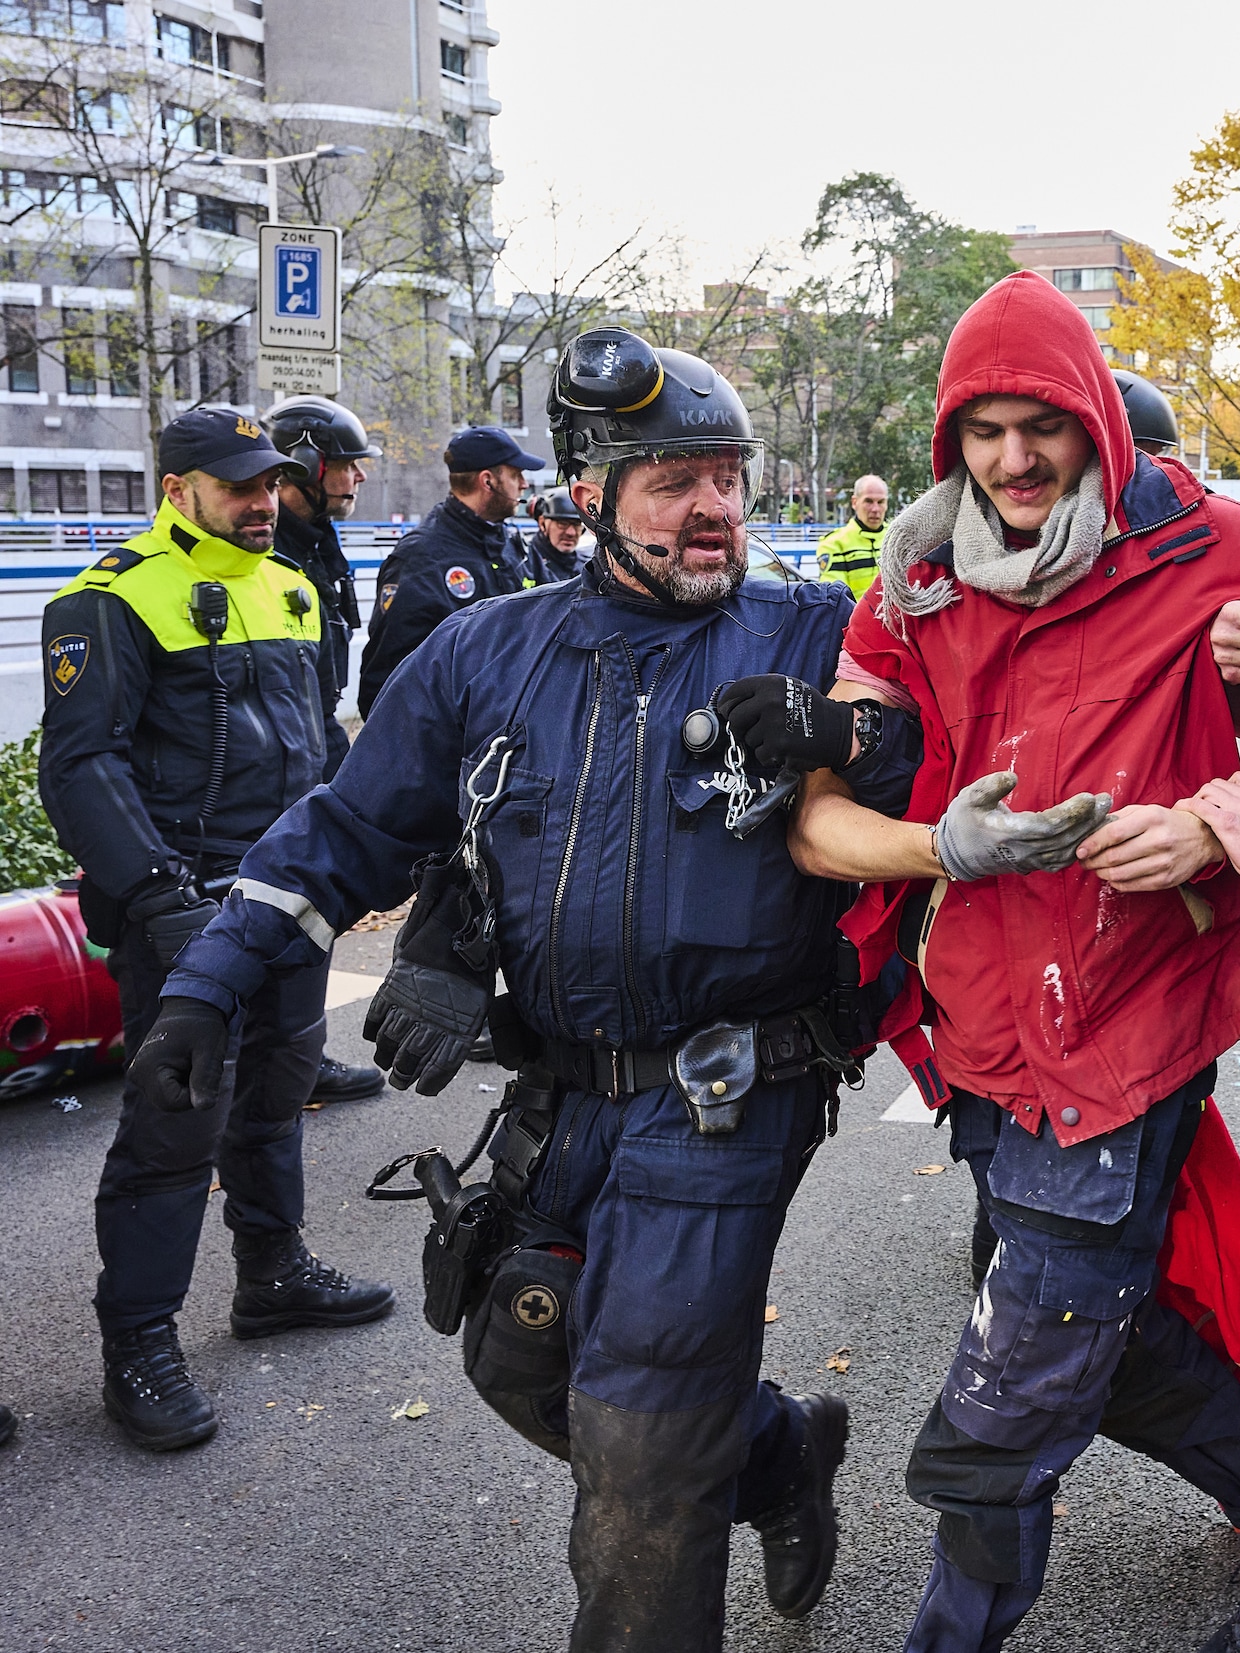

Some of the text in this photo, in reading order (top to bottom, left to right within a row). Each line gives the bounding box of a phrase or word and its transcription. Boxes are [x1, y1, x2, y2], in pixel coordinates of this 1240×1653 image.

[281, 232, 316, 244] ZONE
[289, 251, 313, 262] 1685
[286, 262, 310, 294] P
[269, 325, 326, 340] herhaling
[261, 353, 335, 367] maandag t/m vrijdag
[601, 343, 617, 376] KASK
[679, 409, 734, 427] KASK
[51, 642, 86, 657] POLITIE
